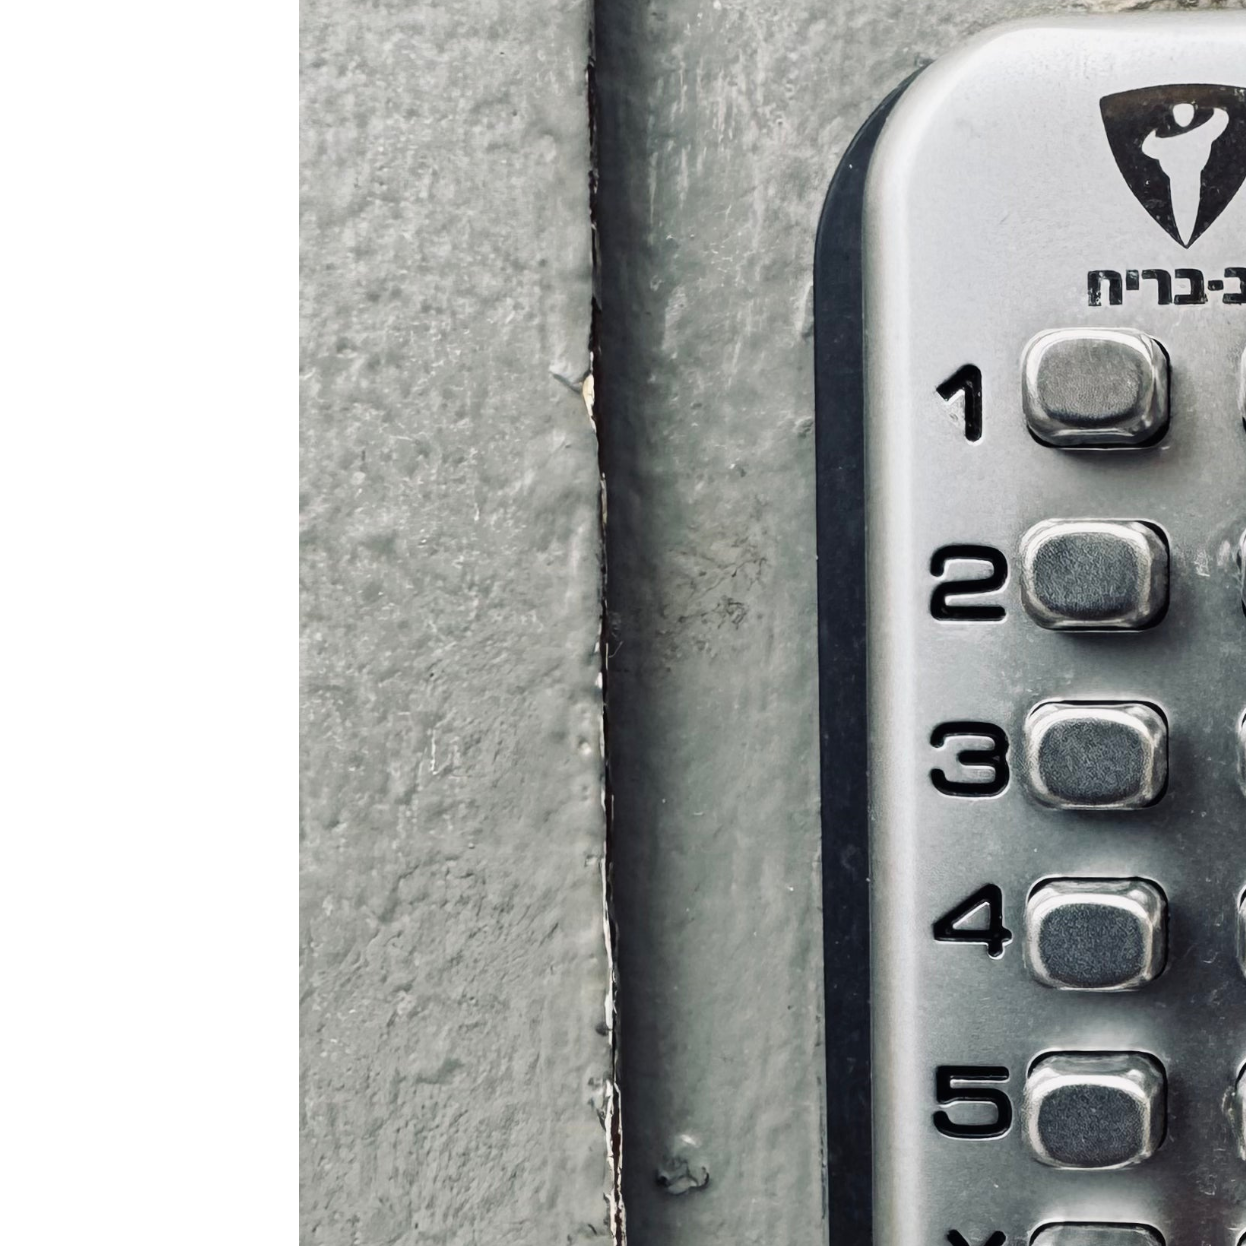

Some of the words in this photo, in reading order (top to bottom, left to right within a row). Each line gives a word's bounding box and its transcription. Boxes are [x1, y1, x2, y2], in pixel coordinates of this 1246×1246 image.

[936, 364, 982, 441] 1
[930, 546, 1008, 618] 2
[929, 721, 1009, 796] 3
[932, 883, 1012, 957] 4
[932, 1065, 1012, 1138] 5
